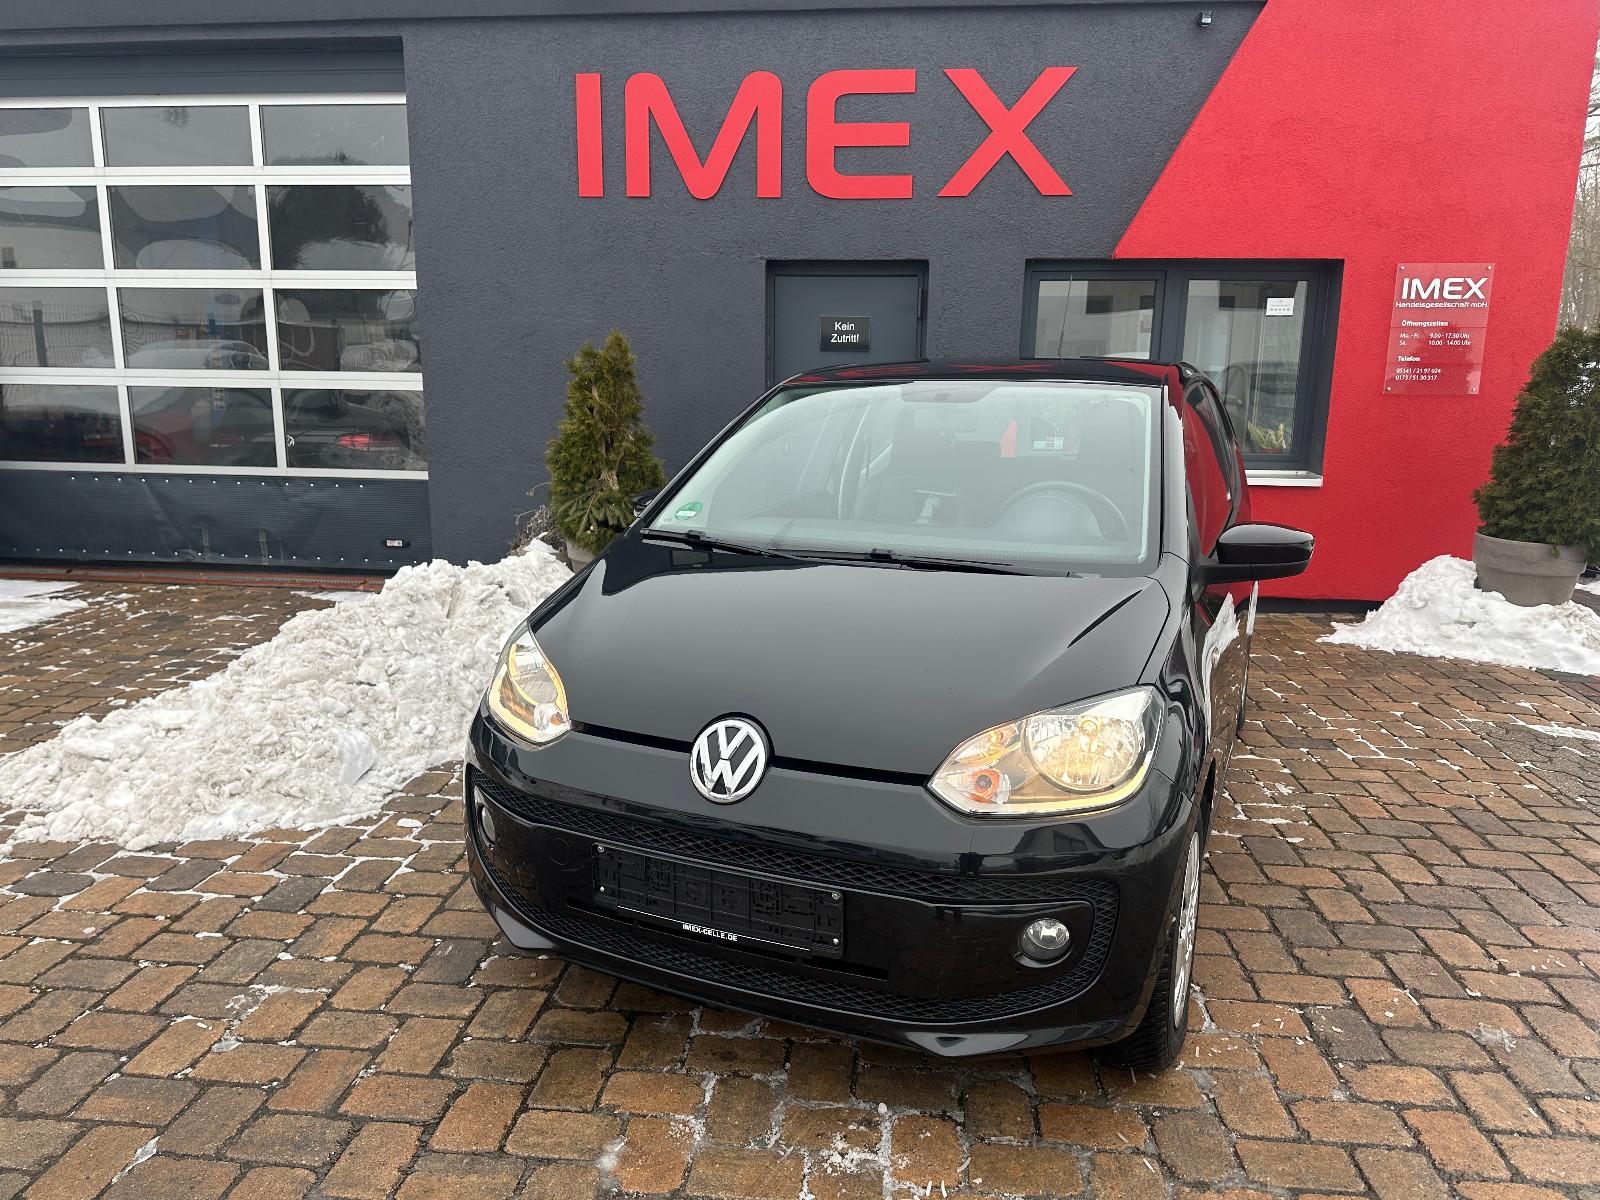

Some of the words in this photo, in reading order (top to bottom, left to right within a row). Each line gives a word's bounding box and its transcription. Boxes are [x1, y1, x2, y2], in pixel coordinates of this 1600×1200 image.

[575, 66, 1078, 200] IMEX
[1401, 277, 1489, 300] IMEX
[1395, 301, 1469, 309] Handelsgesellschaft
[834, 321, 855, 331] Kein
[1401, 320, 1449, 328] Öffnungszeiten
[830, 333, 860, 343] Zutritt!
[682, 923, 738, 942] IMEX-CELLE.DE
